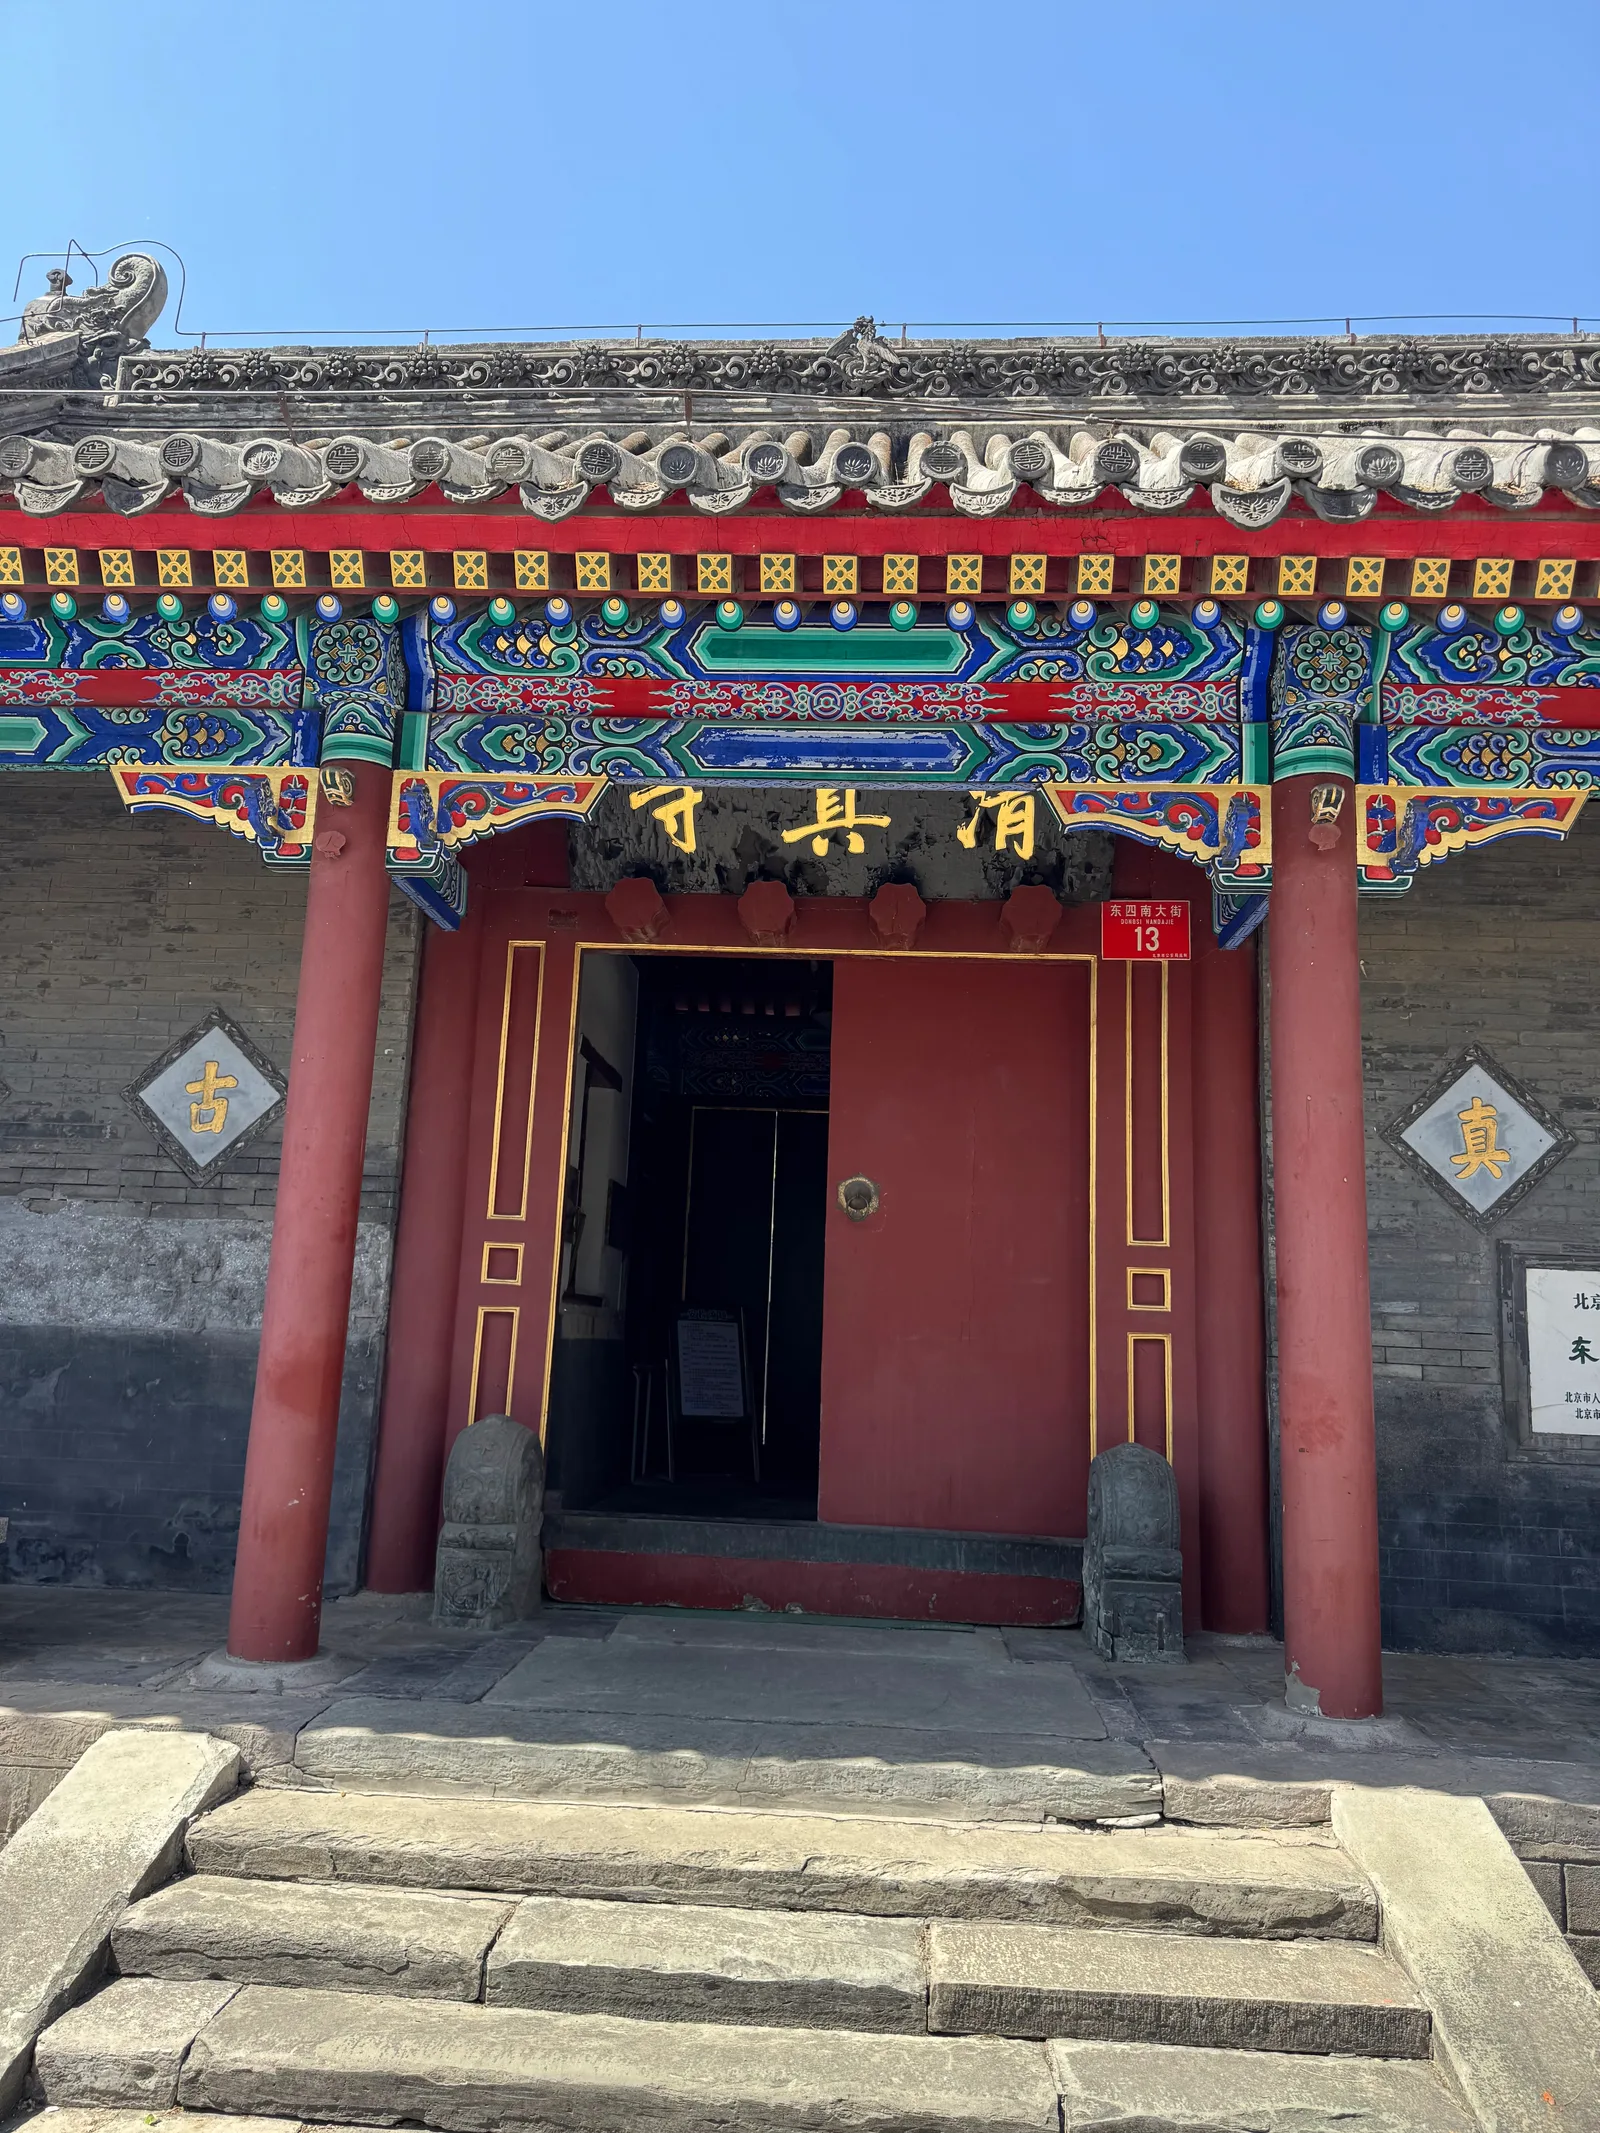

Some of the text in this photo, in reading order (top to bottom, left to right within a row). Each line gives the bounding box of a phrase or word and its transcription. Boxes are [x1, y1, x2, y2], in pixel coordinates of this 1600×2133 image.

[1110, 904, 1182, 918] 东四南大街
[1134, 926, 1159, 952] 13
[184, 1060, 239, 1134] 古
[1449, 1096, 1511, 1179] 真
[1568, 1335, 1600, 1365] 东
